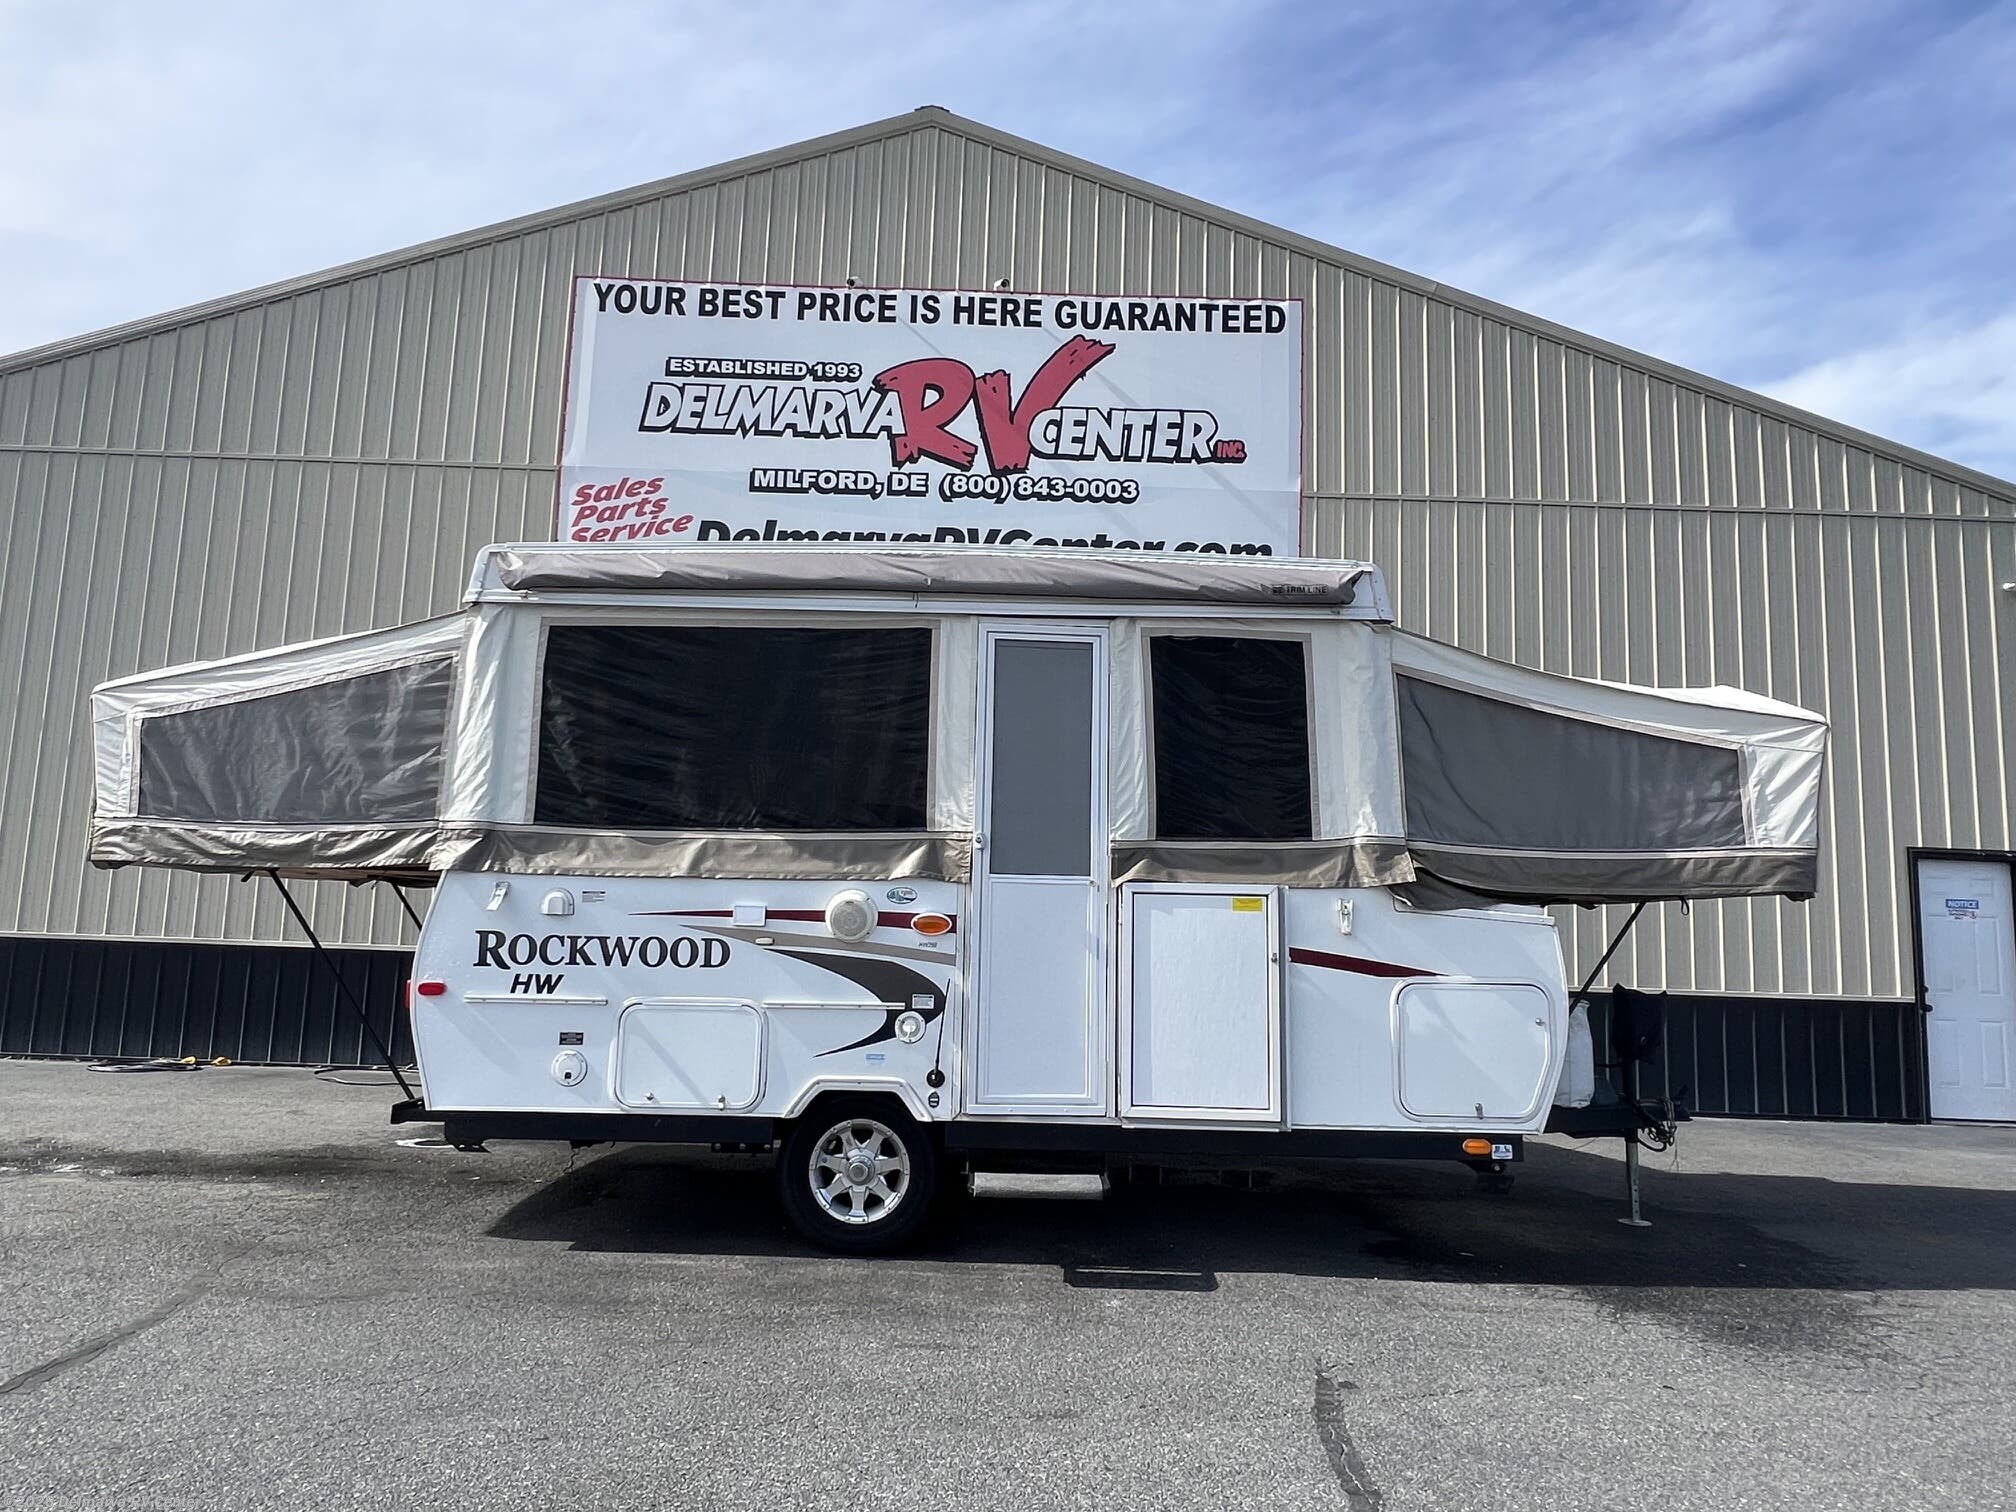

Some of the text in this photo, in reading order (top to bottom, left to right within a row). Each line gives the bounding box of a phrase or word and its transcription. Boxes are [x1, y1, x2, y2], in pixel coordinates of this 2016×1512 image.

[593, 283, 1286, 334] YOUR BEST PRICE IS HERE GUARANTEED
[667, 356, 862, 381] ESTABLISHED 1993
[638, 381, 906, 439] DELMARVA
[872, 334, 1116, 475] RV
[1028, 406, 1218, 464] CENTER
[571, 477, 665, 506] Sales
[749, 468, 1140, 503] MILFORD, DE (800) 843-0003
[571, 498, 669, 527] Parts
[1947, 900, 1977, 908] NOTICE
[473, 929, 731, 970] ROCKWOOD
[510, 973, 564, 994] HW
